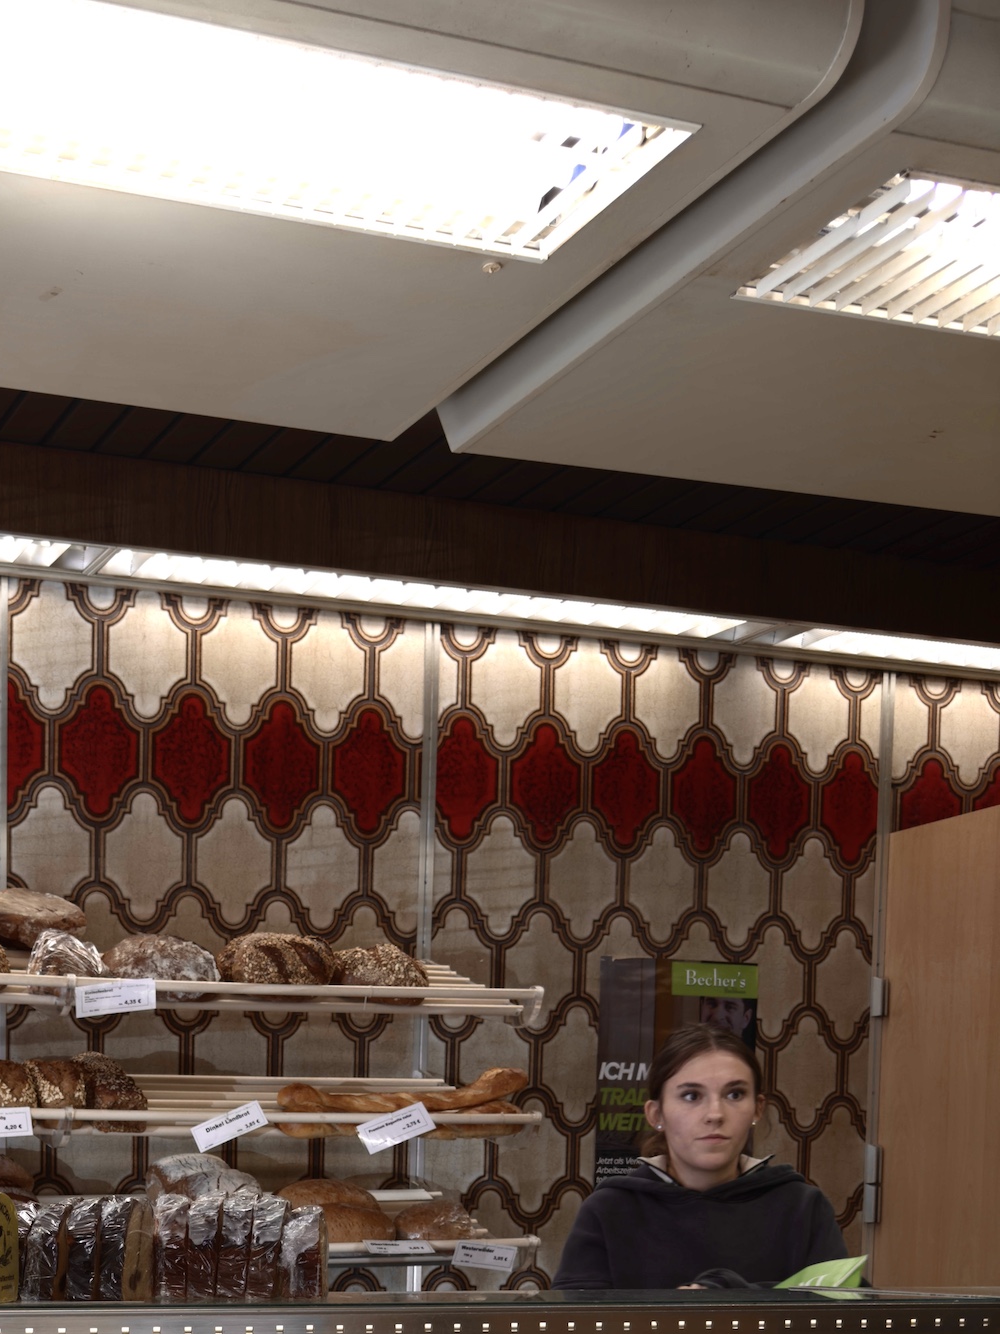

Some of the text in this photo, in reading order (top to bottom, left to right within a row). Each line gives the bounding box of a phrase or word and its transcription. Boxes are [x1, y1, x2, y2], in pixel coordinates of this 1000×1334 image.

[685, 968, 746, 988] Becher's
[598, 1061, 635, 1080] ICH
[205, 1110, 250, 1133] Dinkel Landbrot
[596, 1157, 613, 1165] Jetzt
[613, 1157, 624, 1165] als
